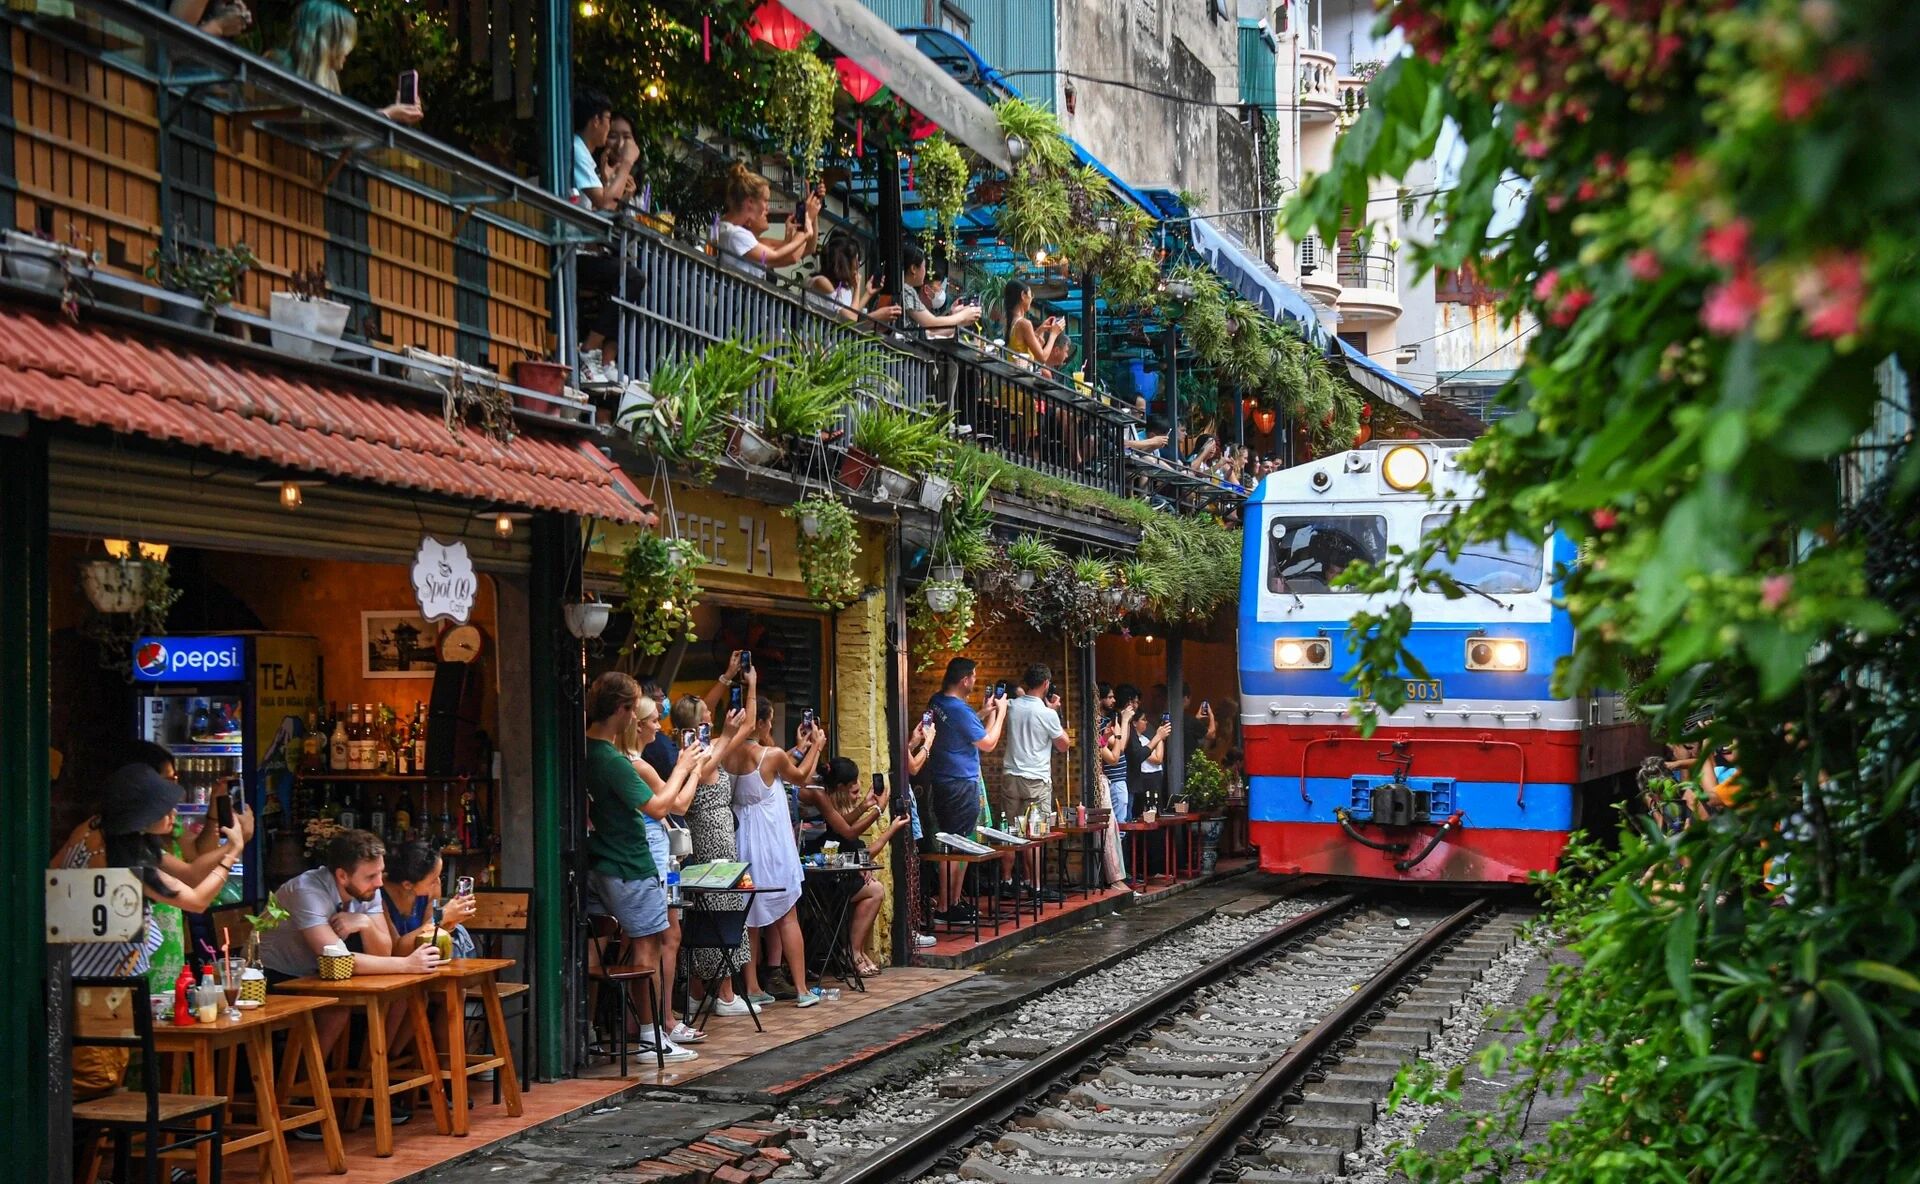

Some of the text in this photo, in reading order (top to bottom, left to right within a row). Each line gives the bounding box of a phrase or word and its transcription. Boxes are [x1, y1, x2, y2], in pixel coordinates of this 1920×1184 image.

[739, 515, 774, 577] 74
[425, 572, 470, 604] Spot 09
[172, 646, 237, 672] pepsi
[260, 663, 298, 691] TEA
[1407, 681, 1438, 700] 903
